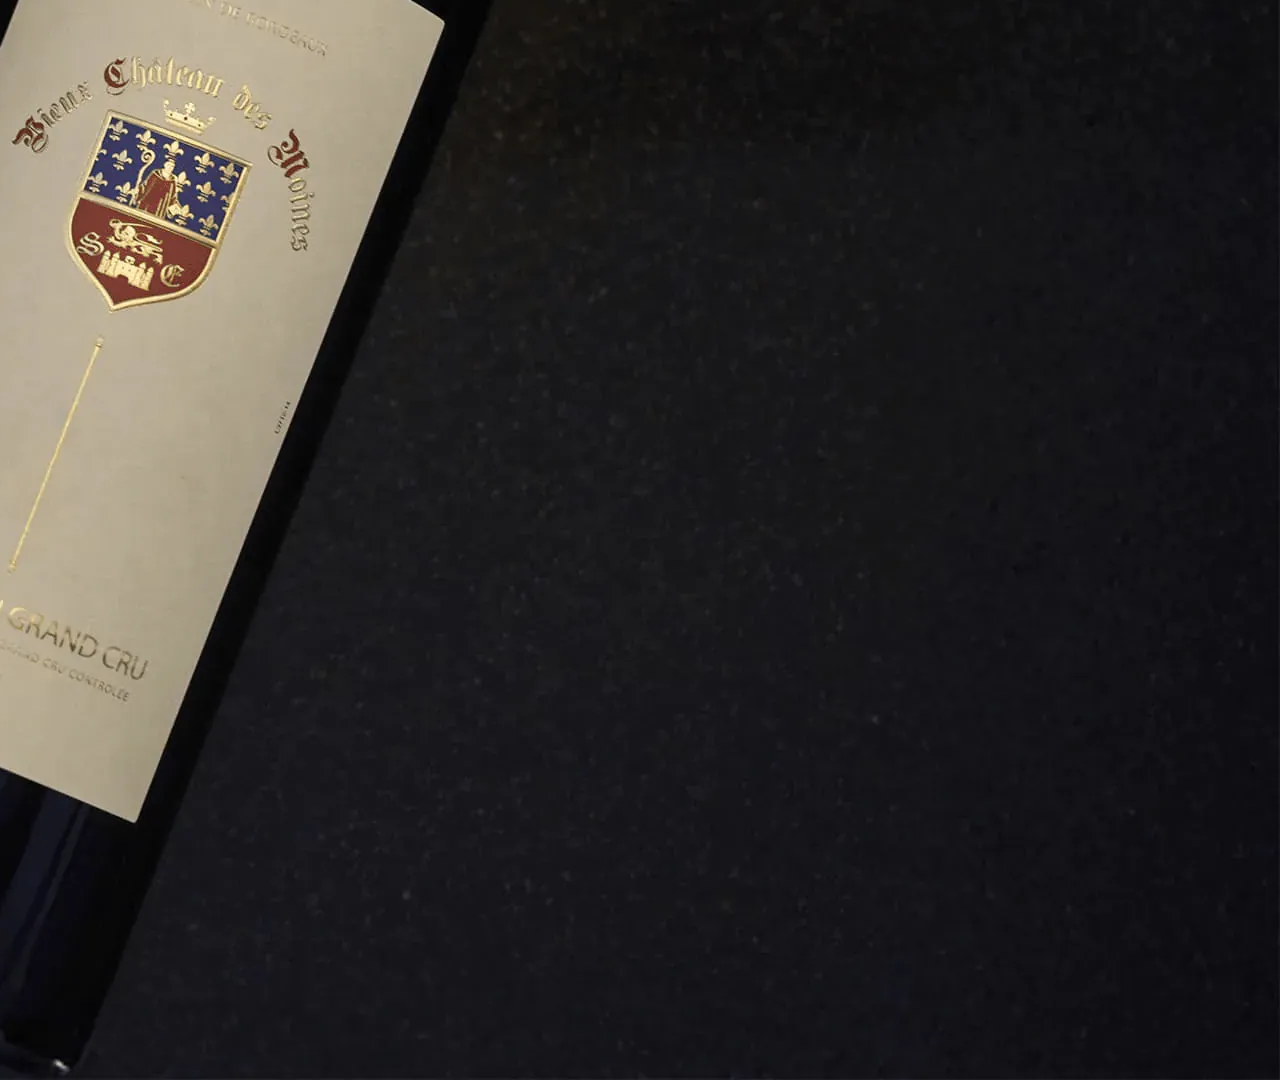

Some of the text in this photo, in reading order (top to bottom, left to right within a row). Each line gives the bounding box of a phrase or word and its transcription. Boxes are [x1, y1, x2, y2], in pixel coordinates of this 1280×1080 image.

[11, 56, 316, 253] Vieux Château des Moines
[7, 606, 100, 659] GRAND
[101, 645, 149, 681] CRU
